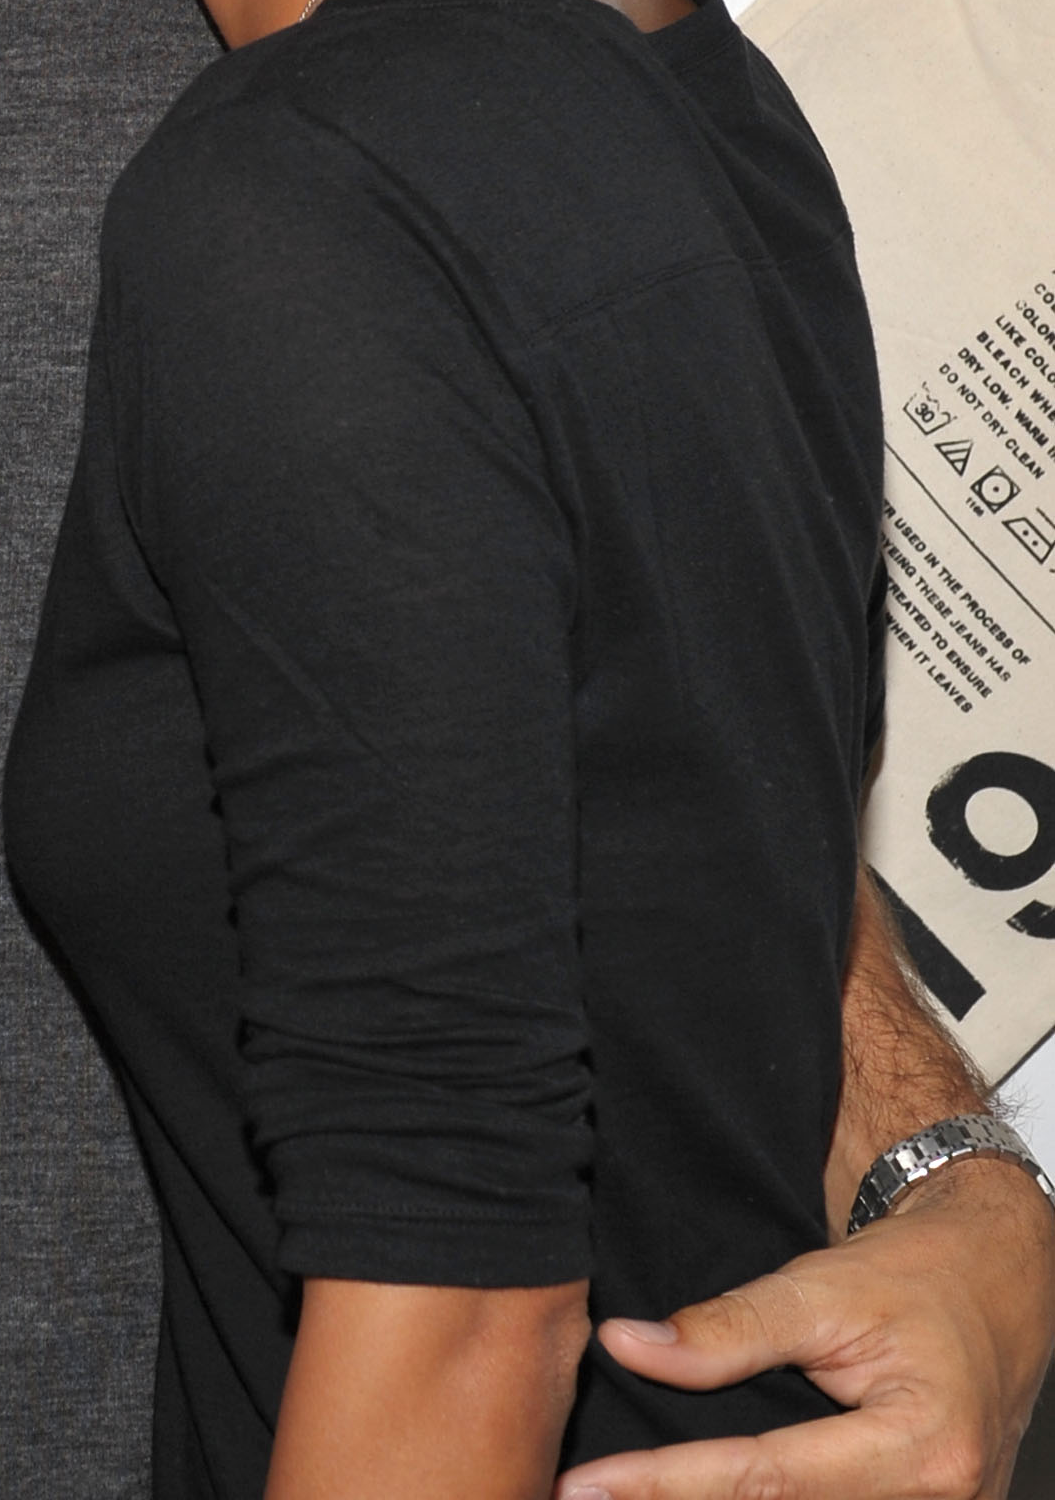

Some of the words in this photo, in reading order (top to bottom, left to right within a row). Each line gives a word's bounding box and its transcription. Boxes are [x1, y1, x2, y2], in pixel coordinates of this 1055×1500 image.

[976, 330, 1030, 389] BLEACH
[995, 314, 1027, 348] LIKE
[1024, 347, 1055, 388] COLO
[1015, 299, 1055, 352] COLOR
[915, 402, 935, 423] 30
[939, 363, 959, 384] DO
[957, 383, 985, 411] NOT
[981, 411, 1008, 438] DRY
[1005, 438, 1045, 480] CLEAN
[957, 347, 985, 374] DRY
[982, 375, 1013, 410] LOW.
[1014, 408, 1050, 447] WARM
[894, 517, 926, 553] USED
[923, 552, 940, 569] IN
[938, 566, 964, 594] THE
[959, 592, 1014, 650] PROCESS
[1011, 648, 1031, 665] OF
[915, 576, 953, 619] THESE
[949, 619, 988, 658] JEANS
[985, 656, 1012, 682] HAS
[914, 651, 931, 665] IT
[927, 665, 973, 713] LEAVES
[931, 631, 949, 651] TO
[946, 649, 993, 698] ENSURE
